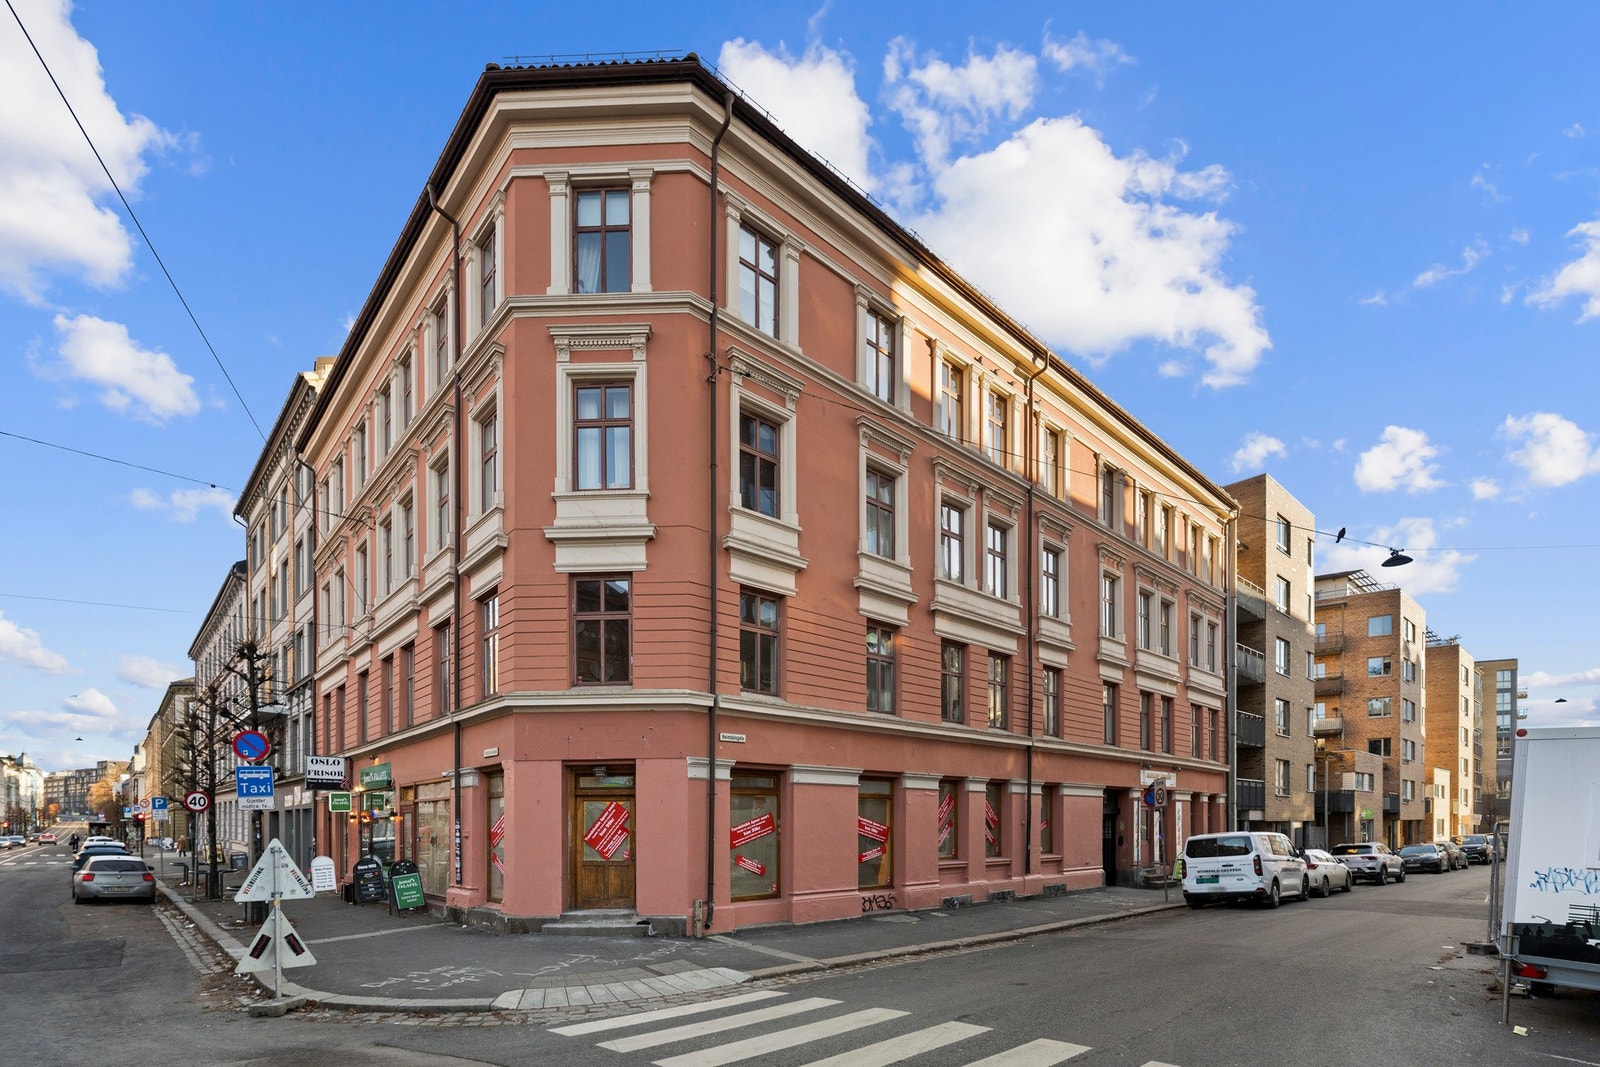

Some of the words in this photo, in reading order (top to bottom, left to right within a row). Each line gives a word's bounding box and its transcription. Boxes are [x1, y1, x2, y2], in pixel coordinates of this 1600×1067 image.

[311, 758, 340, 766] OSLO
[240, 782, 271, 793] Taxi
[155, 798, 164, 808] P
[189, 796, 206, 807] 40
